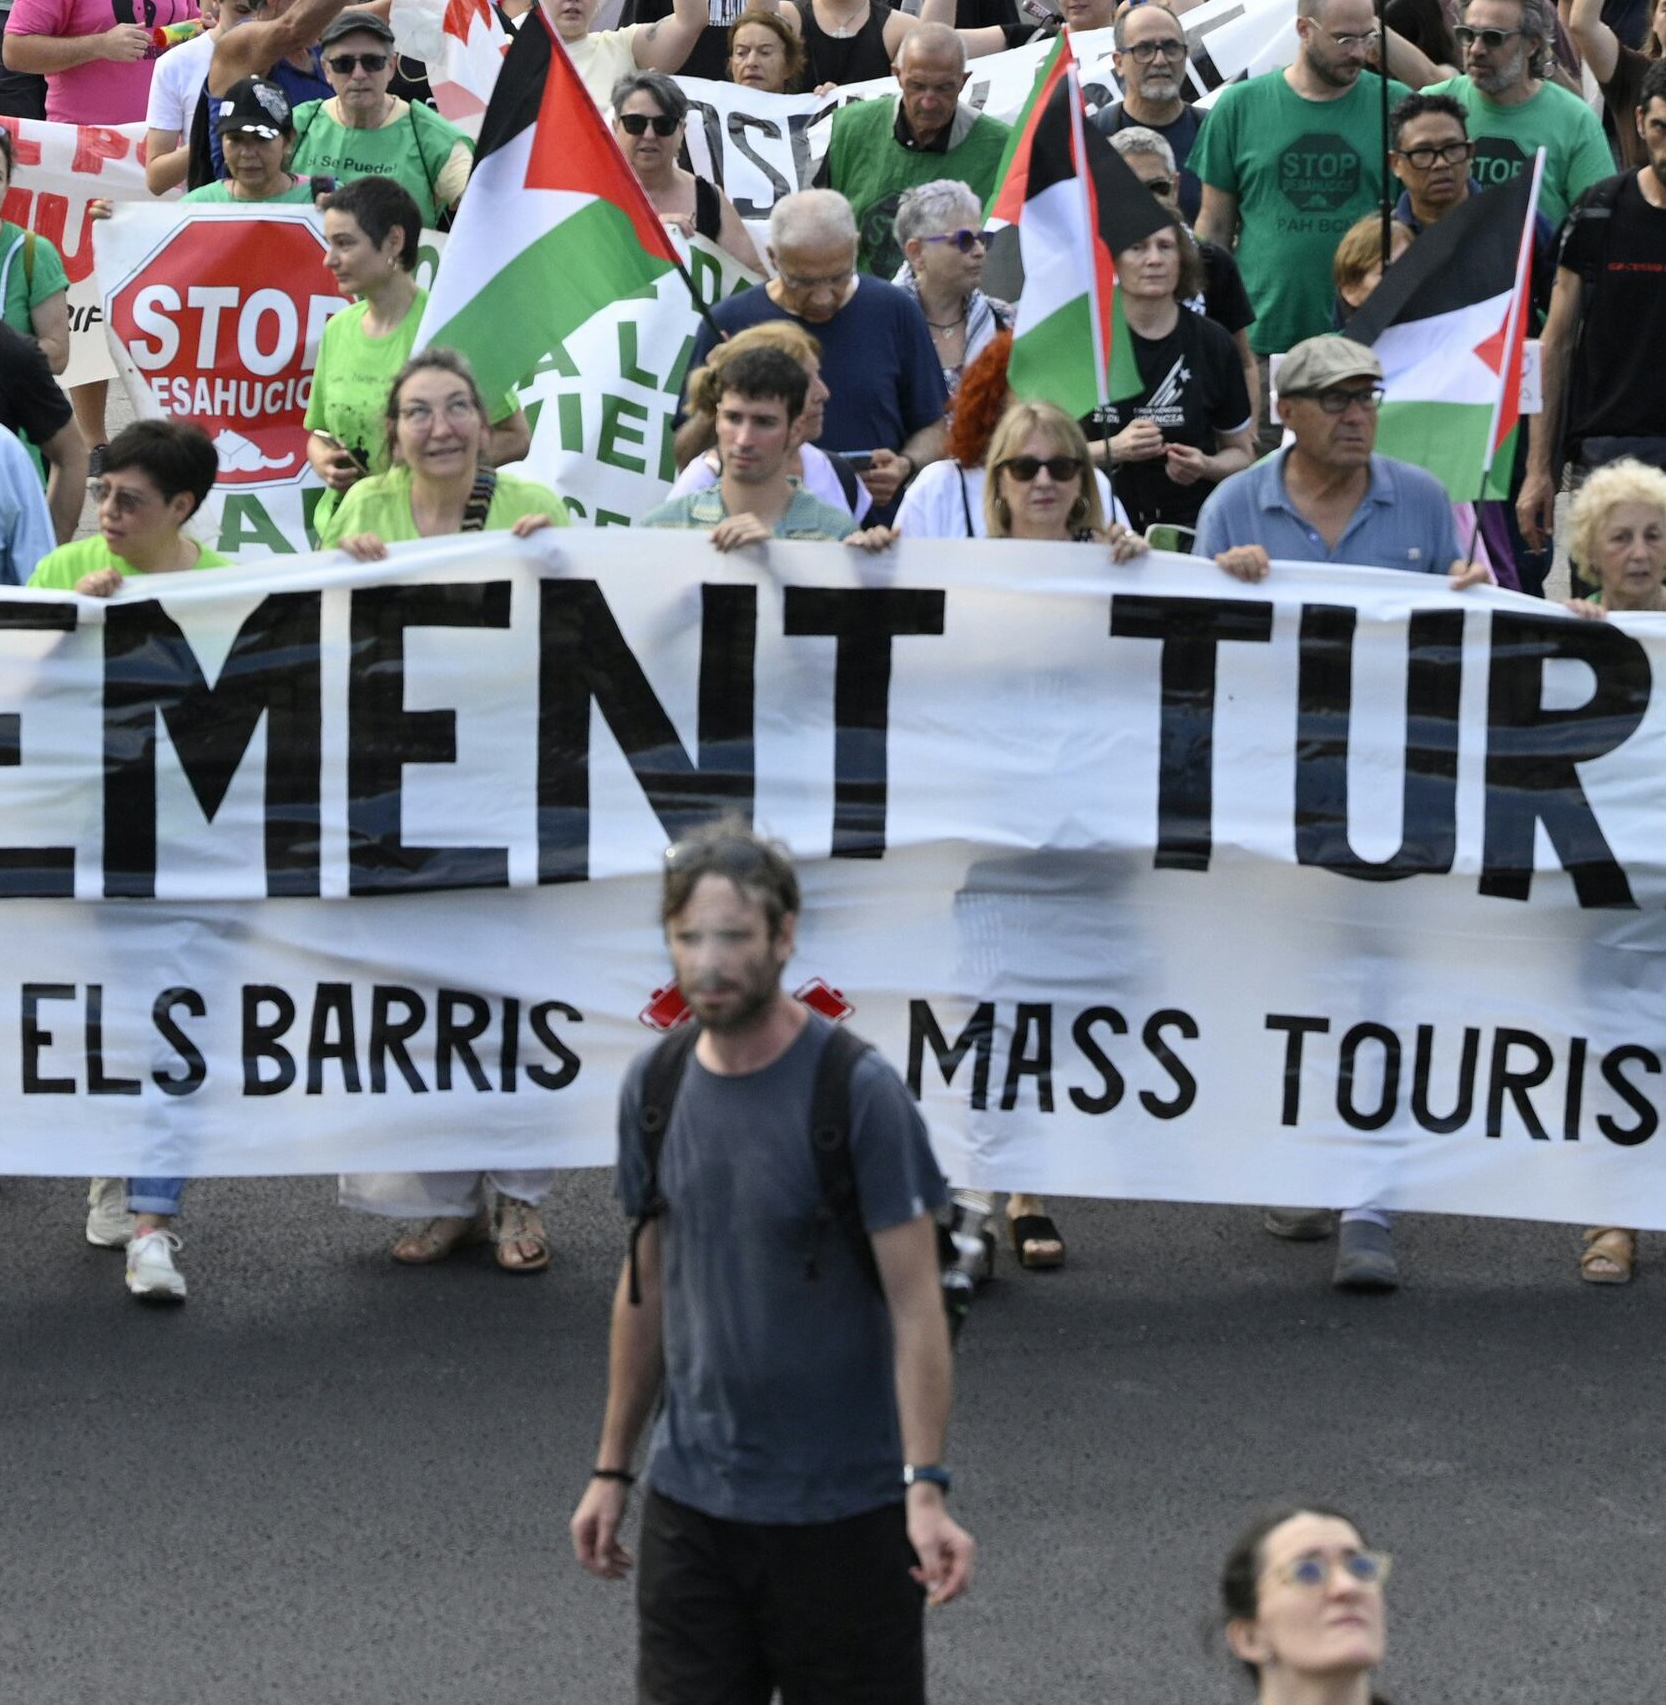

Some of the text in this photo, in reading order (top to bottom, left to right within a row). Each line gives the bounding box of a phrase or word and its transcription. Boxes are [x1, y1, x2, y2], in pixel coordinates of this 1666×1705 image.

[321, 156, 399, 176] Se Puede!
[1282, 152, 1359, 178] STOP
[1278, 217, 1354, 233] PAH BCN
[150, 376, 317, 419] ESAHUCIO
[22, 981, 207, 1097] ELS
[240, 982, 583, 1095] BARRIS
[906, 999, 1200, 1121] MASS
